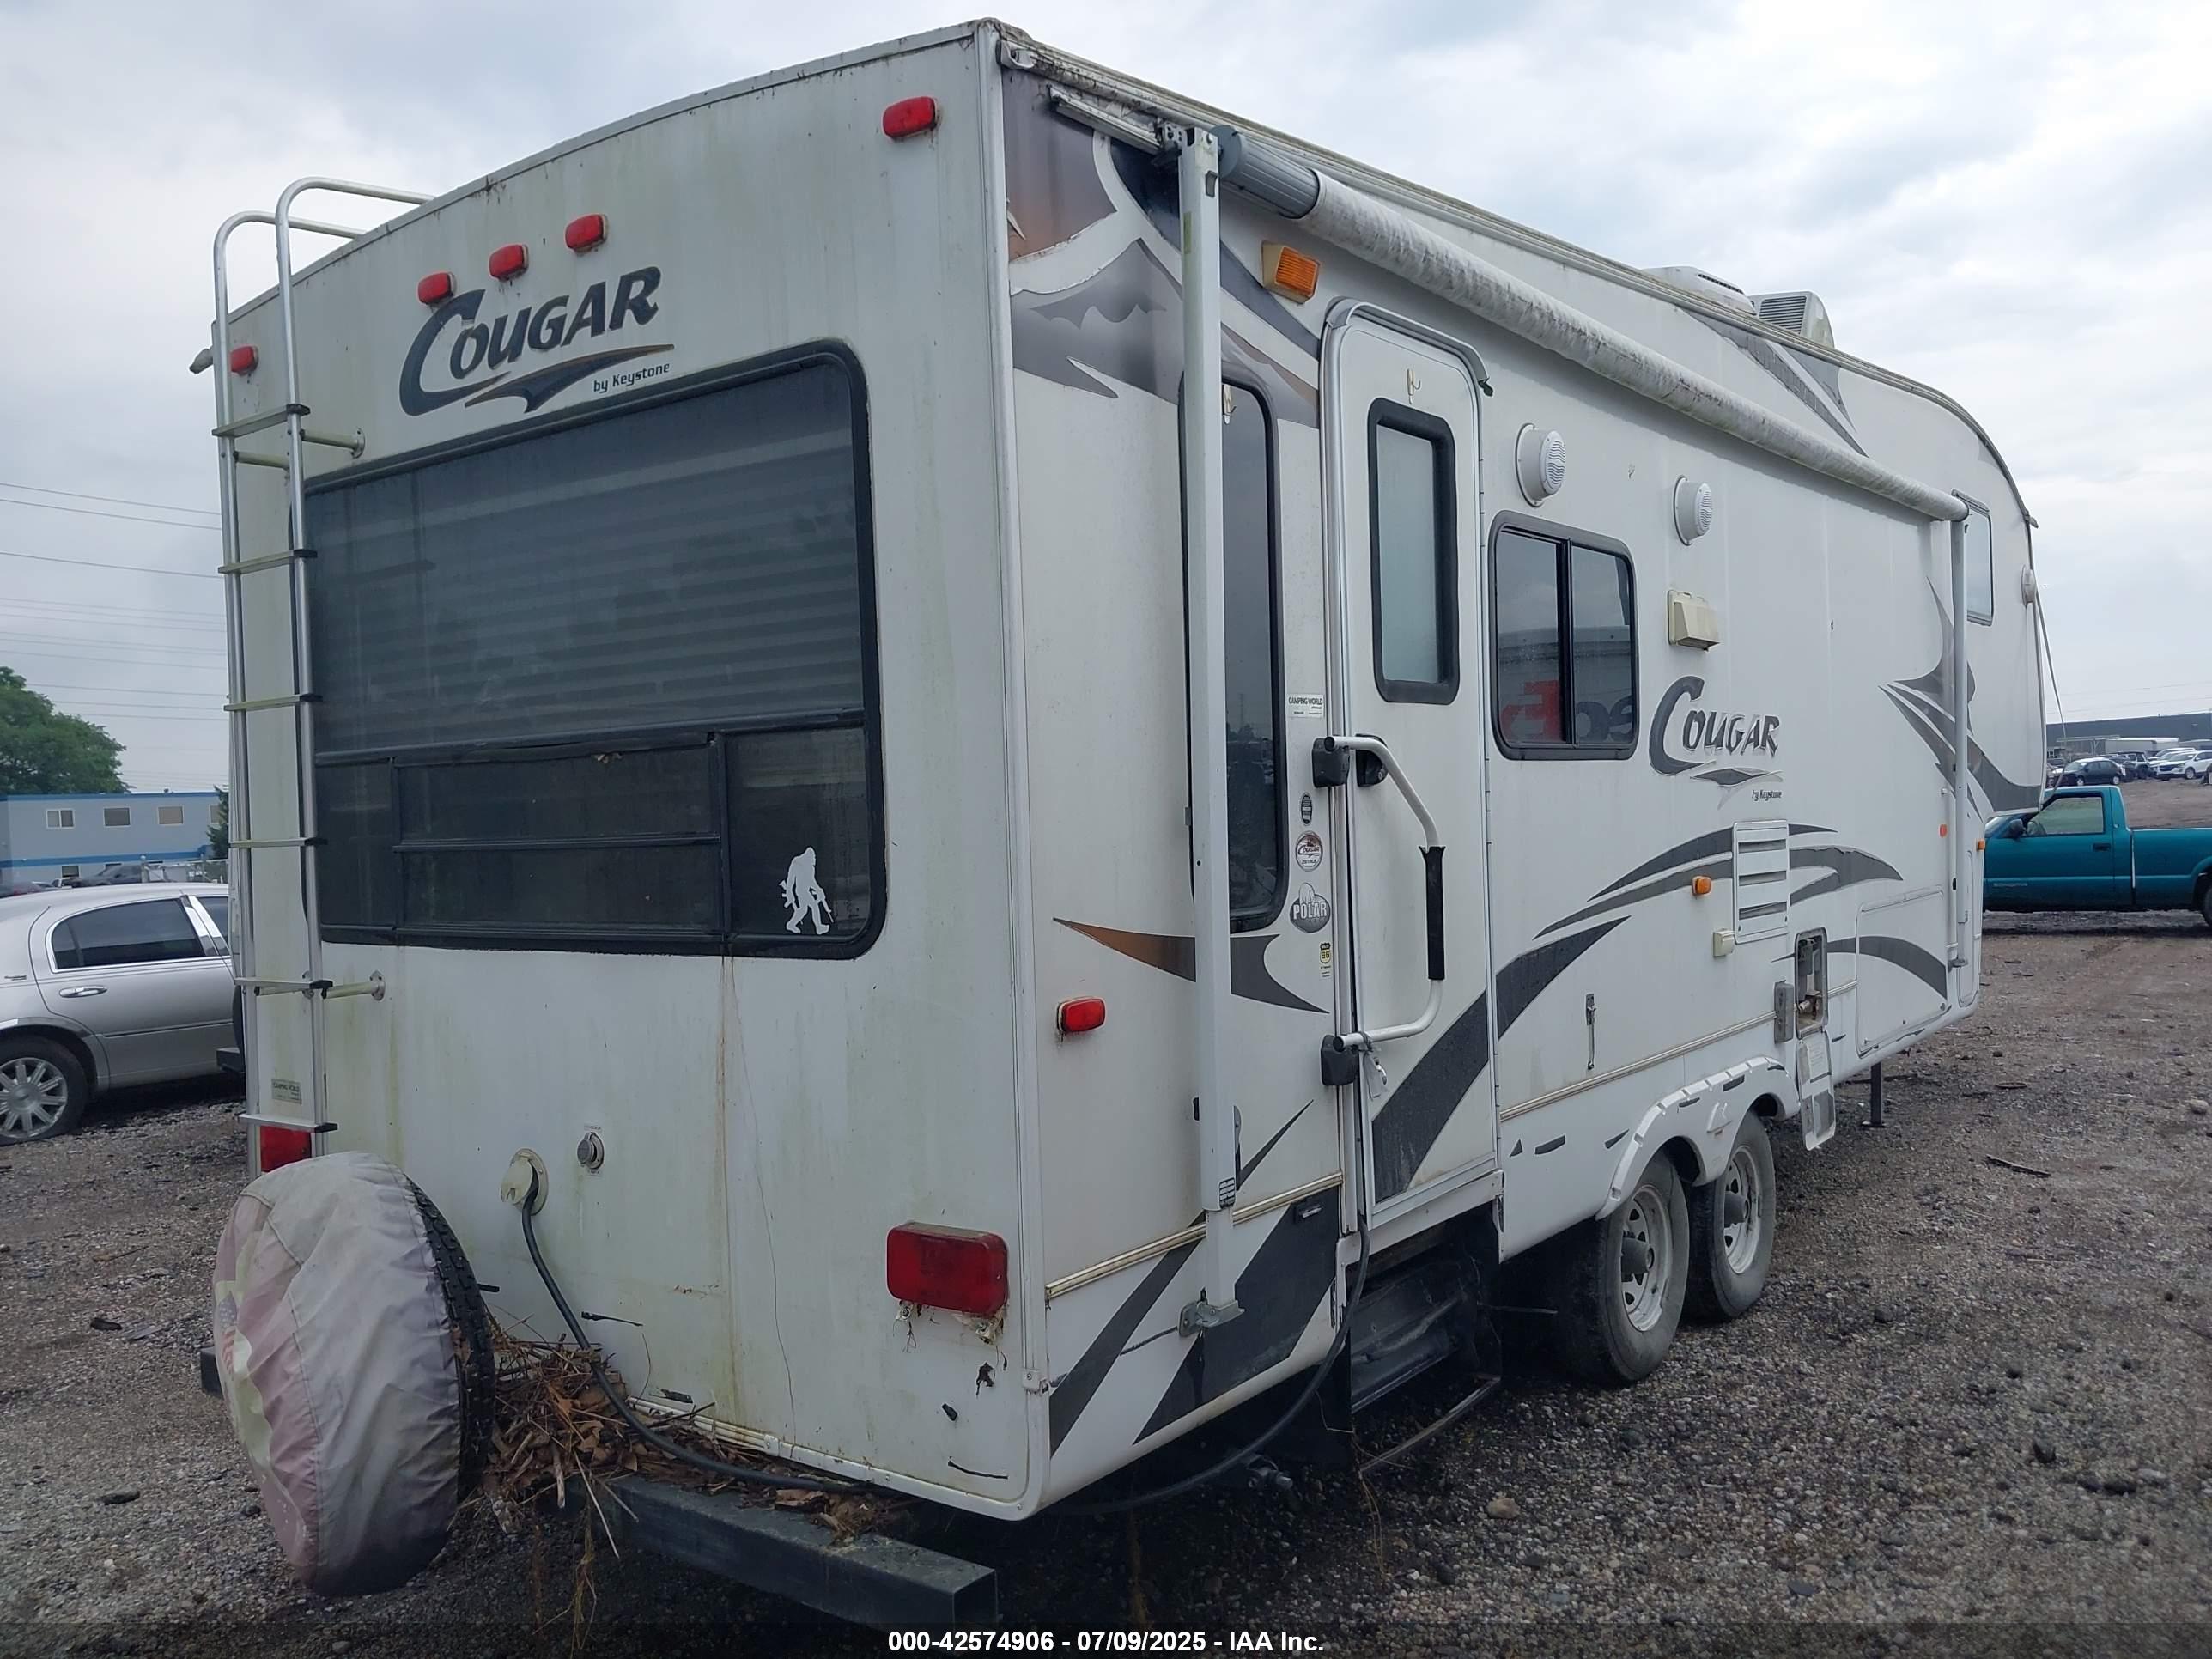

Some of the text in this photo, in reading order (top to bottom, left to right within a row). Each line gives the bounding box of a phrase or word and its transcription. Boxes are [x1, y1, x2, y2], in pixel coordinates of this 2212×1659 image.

[593, 362, 671, 393] by Keystone
[1288, 696, 1308, 705] CAMPING
[1293, 902, 1327, 920] POLAR
